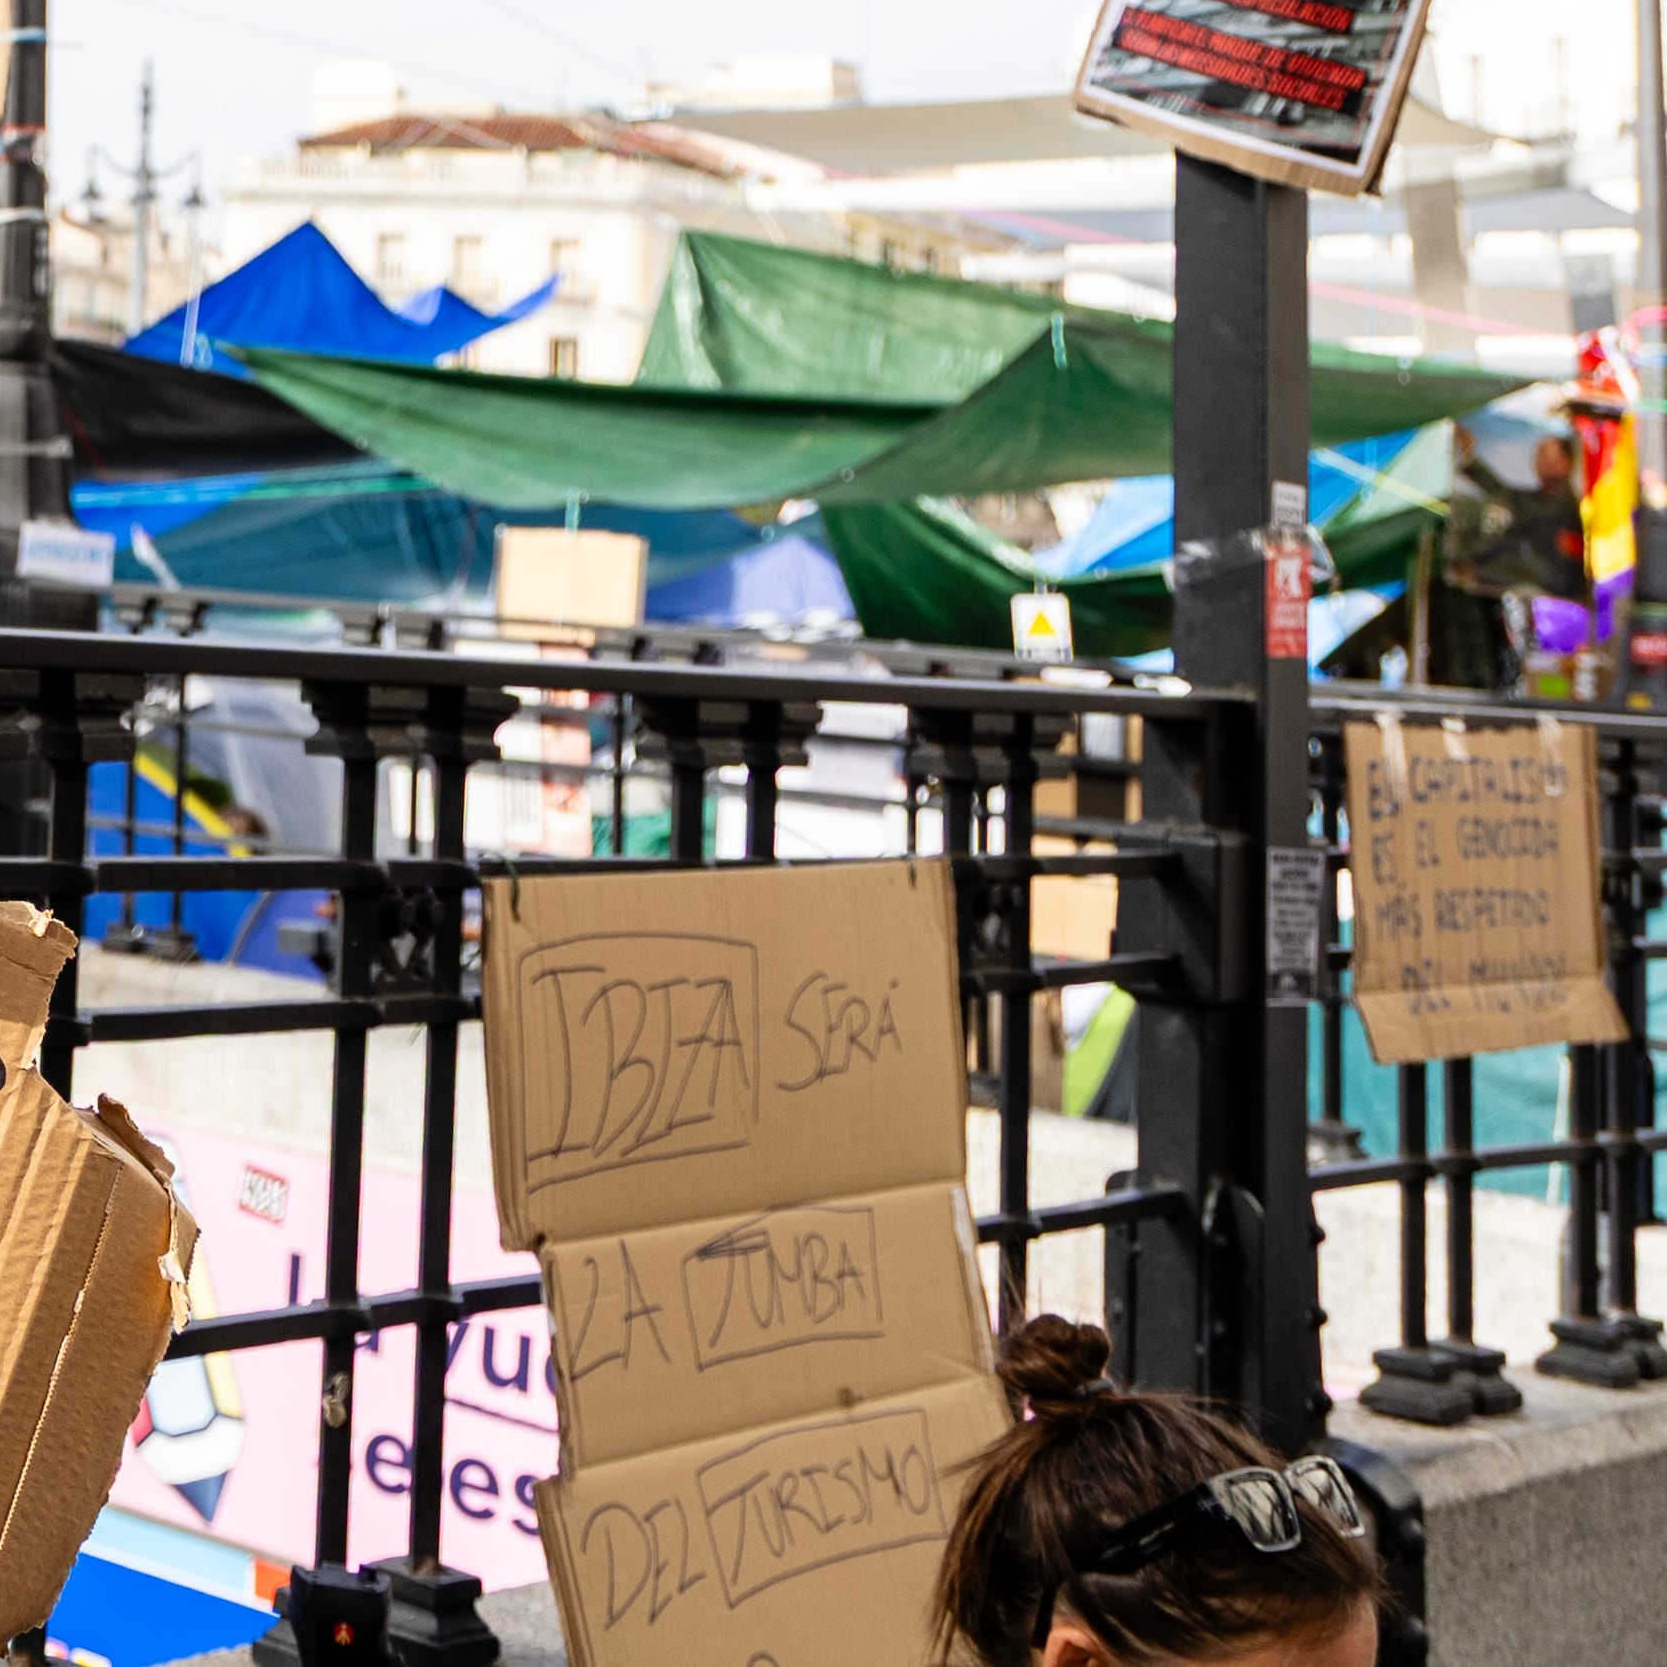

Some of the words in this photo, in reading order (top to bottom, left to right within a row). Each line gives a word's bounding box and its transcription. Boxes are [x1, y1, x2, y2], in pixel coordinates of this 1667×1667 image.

[776, 971, 903, 1092] SERÁ
[569, 1238, 671, 1382] LA
[695, 1228, 866, 1348] TUMBA
[580, 1500, 706, 1632] DEL
[707, 1445, 930, 1584] TURISMO
